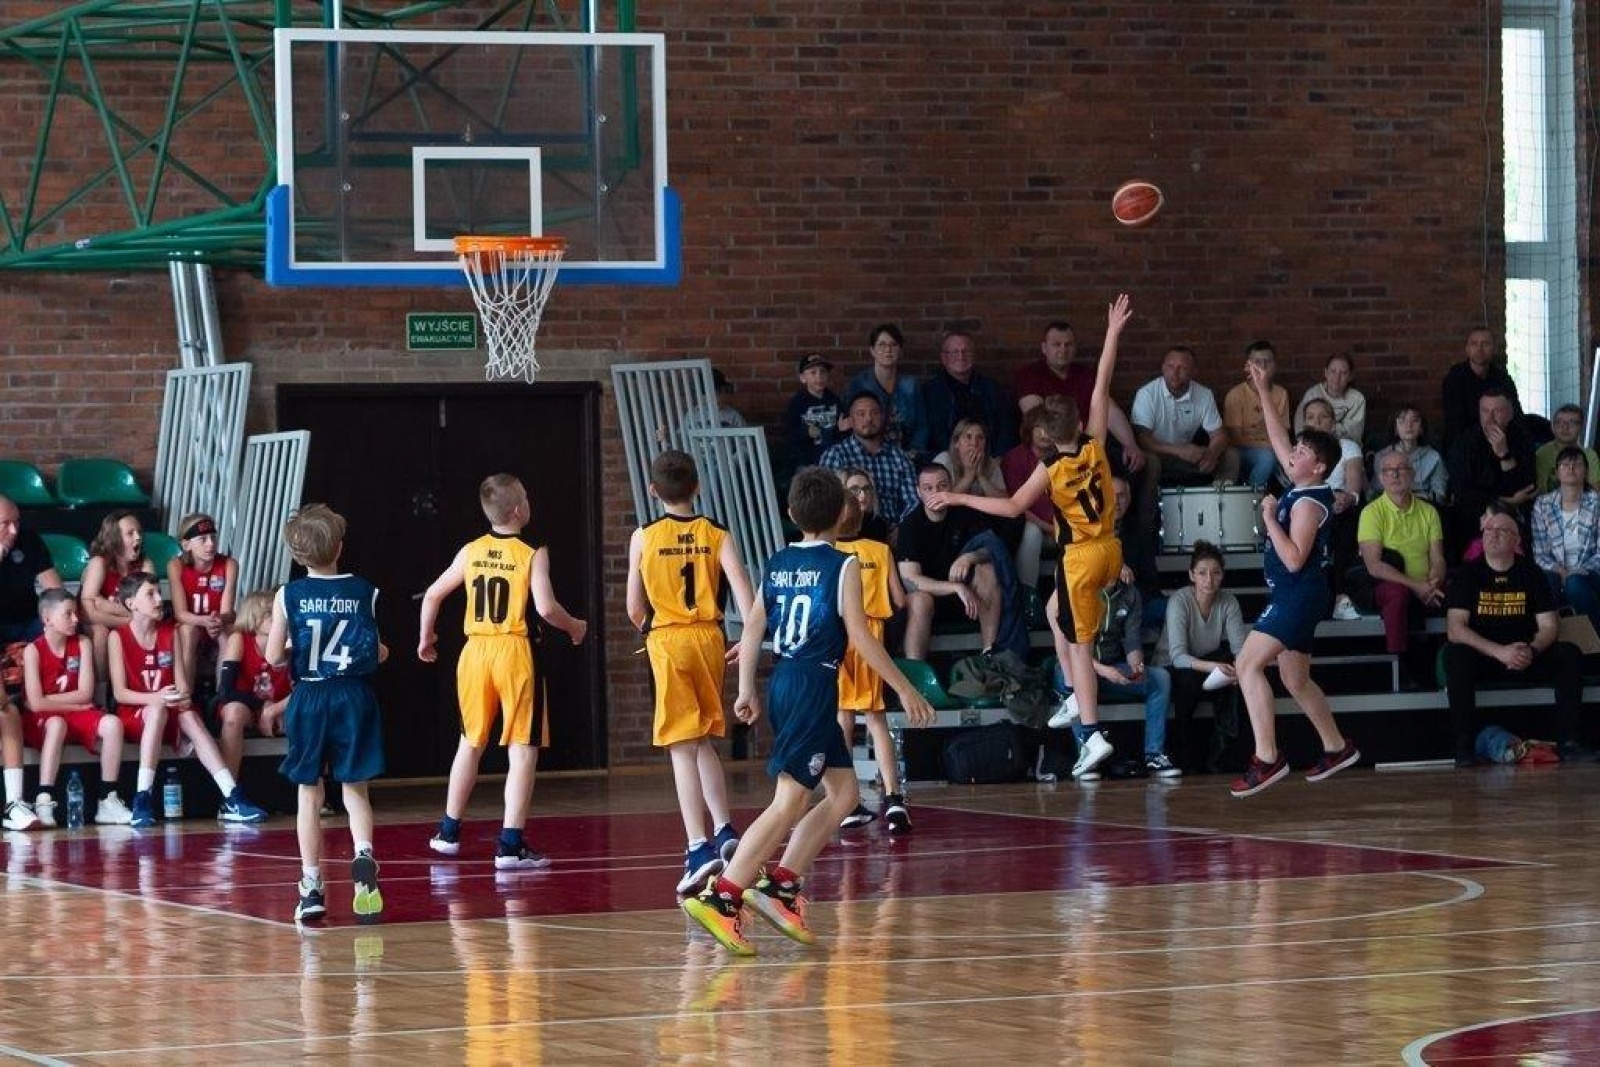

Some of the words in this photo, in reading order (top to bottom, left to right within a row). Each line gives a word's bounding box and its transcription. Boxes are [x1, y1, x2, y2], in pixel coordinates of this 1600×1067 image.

[413, 319, 470, 332] WYJŚCIE
[680, 562, 696, 611] 1
[770, 571, 793, 588] SARI
[299, 599, 329, 614] SARI
[472, 574, 510, 624] 10
[305, 619, 353, 671] 14
